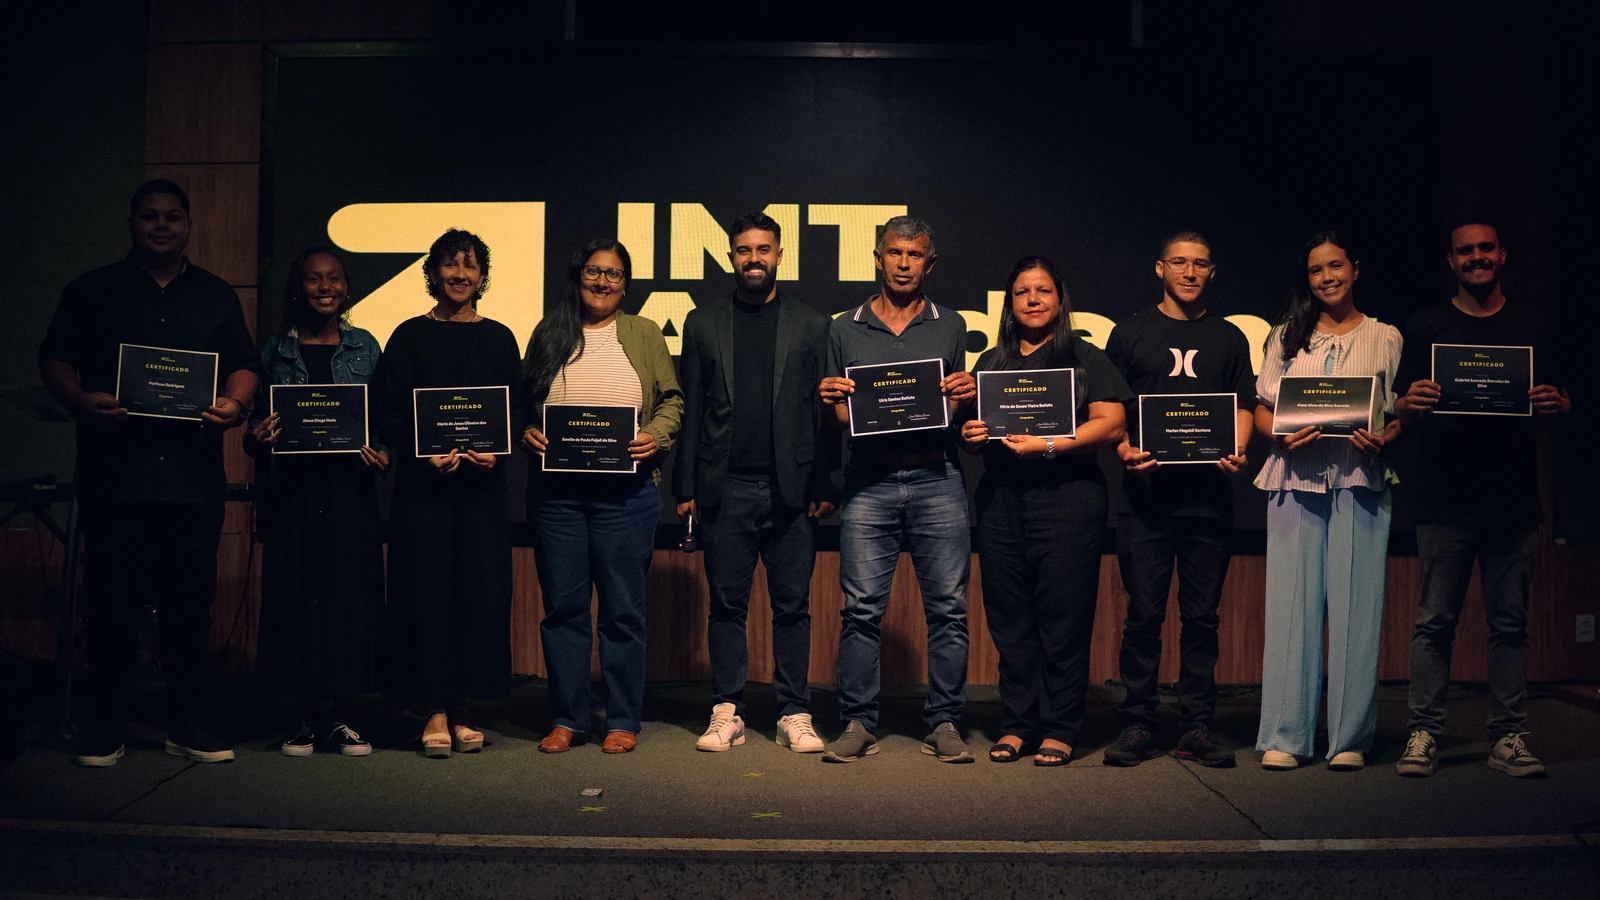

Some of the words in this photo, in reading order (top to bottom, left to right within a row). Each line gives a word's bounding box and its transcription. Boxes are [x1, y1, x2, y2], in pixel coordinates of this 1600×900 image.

[617, 202, 909, 281] IMT
[146, 364, 189, 372] CERTIFICADO
[874, 378, 916, 387] CERTIFICADO
